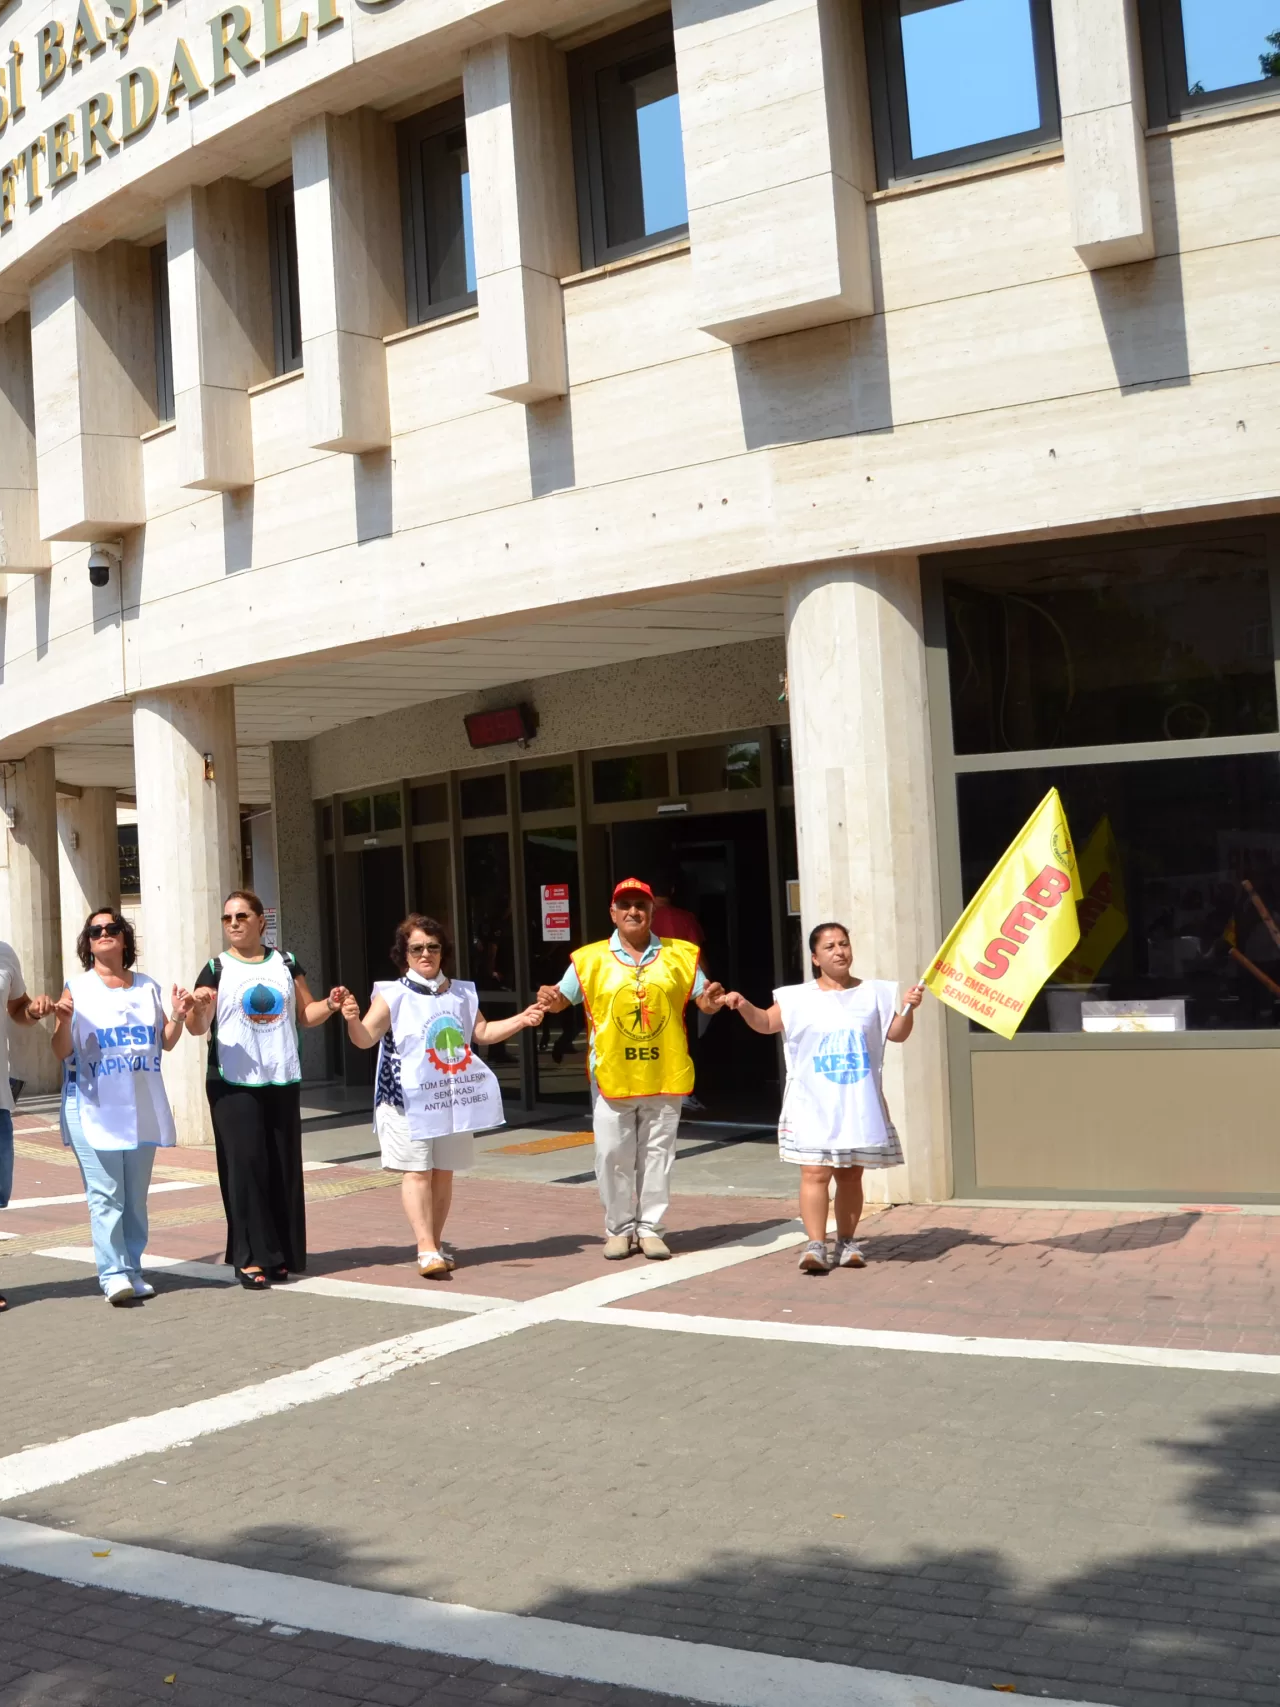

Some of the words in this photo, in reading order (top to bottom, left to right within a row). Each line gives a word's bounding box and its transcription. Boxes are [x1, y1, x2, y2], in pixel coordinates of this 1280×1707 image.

[974, 865, 1070, 980] BES
[933, 960, 964, 982] BÜRO
[963, 976, 1026, 1013] EMEKÇİLERİ
[942, 984, 997, 1018] SENDİKASI
[625, 1047, 660, 1061] BES
[88, 1055, 150, 1078] YAPI-YOL
[420, 1081, 438, 1091] TÜM
[439, 1072, 486, 1088] EMEKLİLERİN
[434, 1086, 475, 1100] SENDİKASI
[462, 1092, 489, 1106] ŞUBESİ
